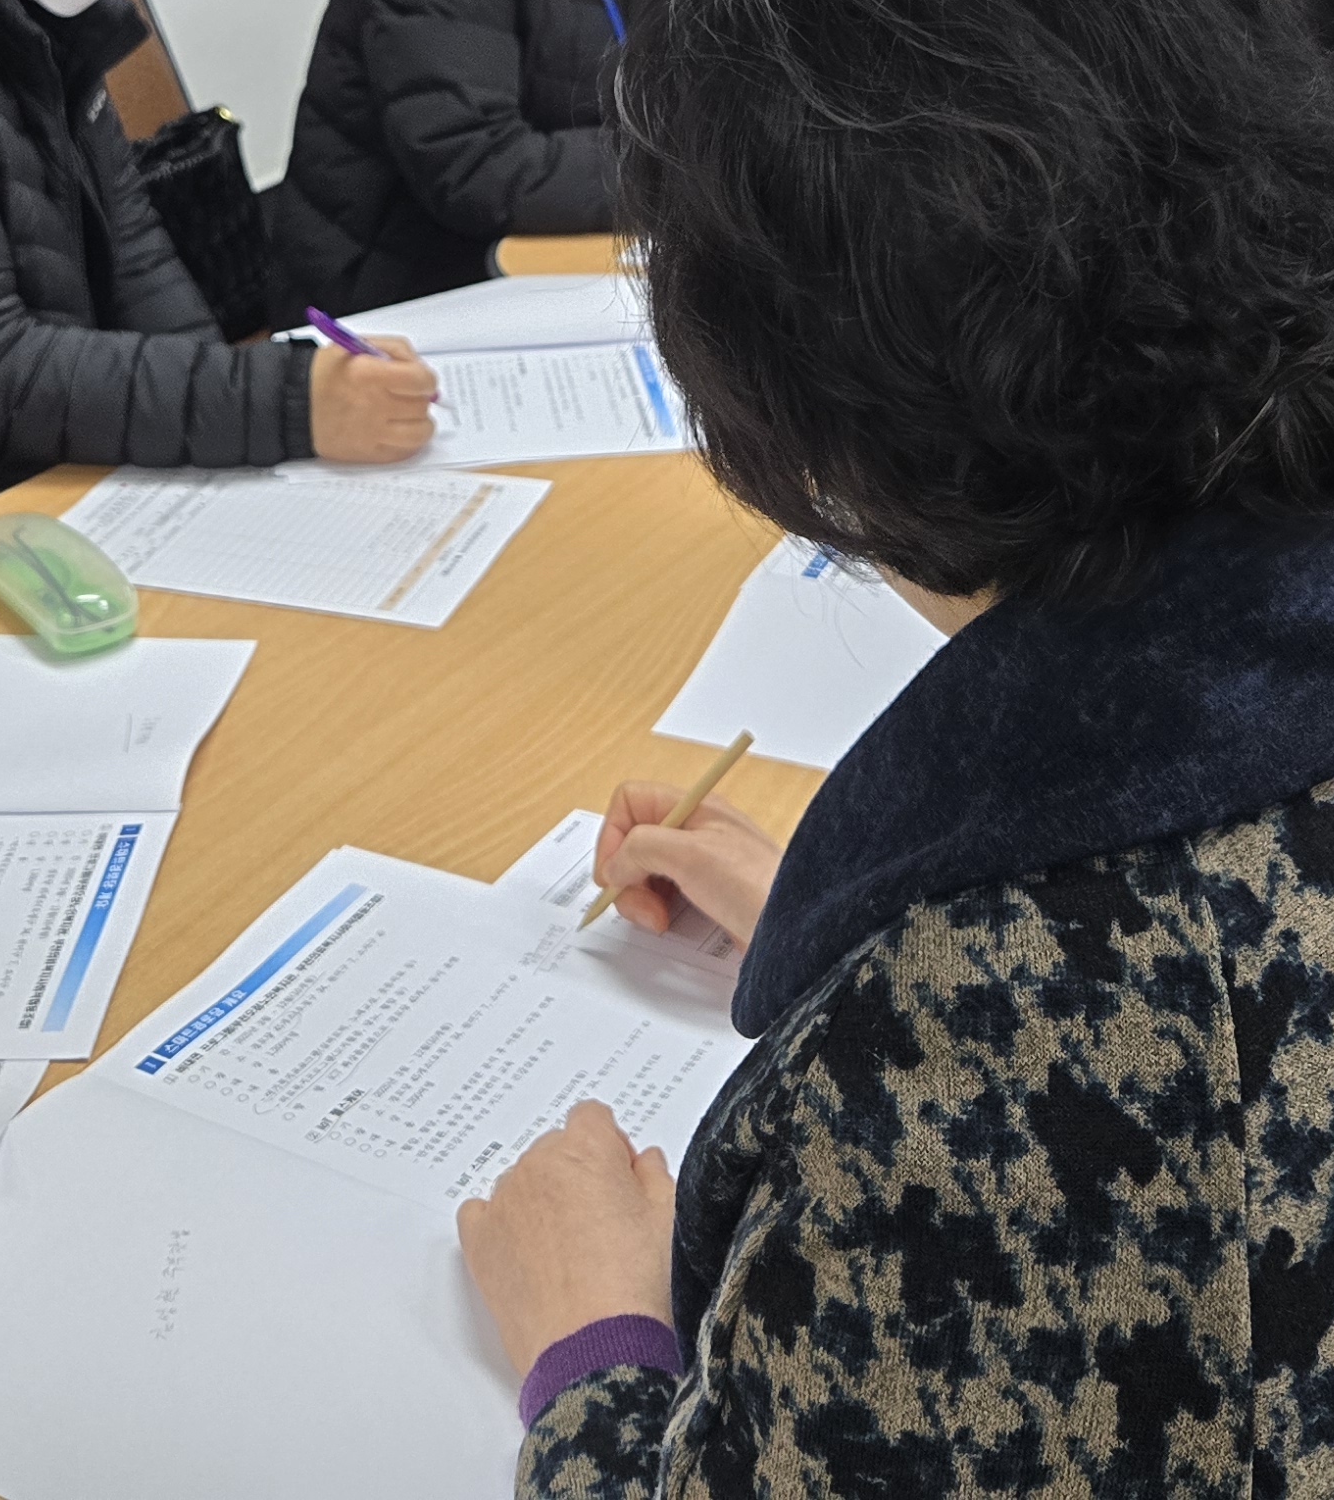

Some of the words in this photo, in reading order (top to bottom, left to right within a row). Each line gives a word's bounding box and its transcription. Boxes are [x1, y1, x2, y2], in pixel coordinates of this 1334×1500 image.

[162, 1006, 225, 1053] 스마트경로당
[220, 989, 247, 1006] 개요
[329, 1088, 365, 1116] 헬스케어
